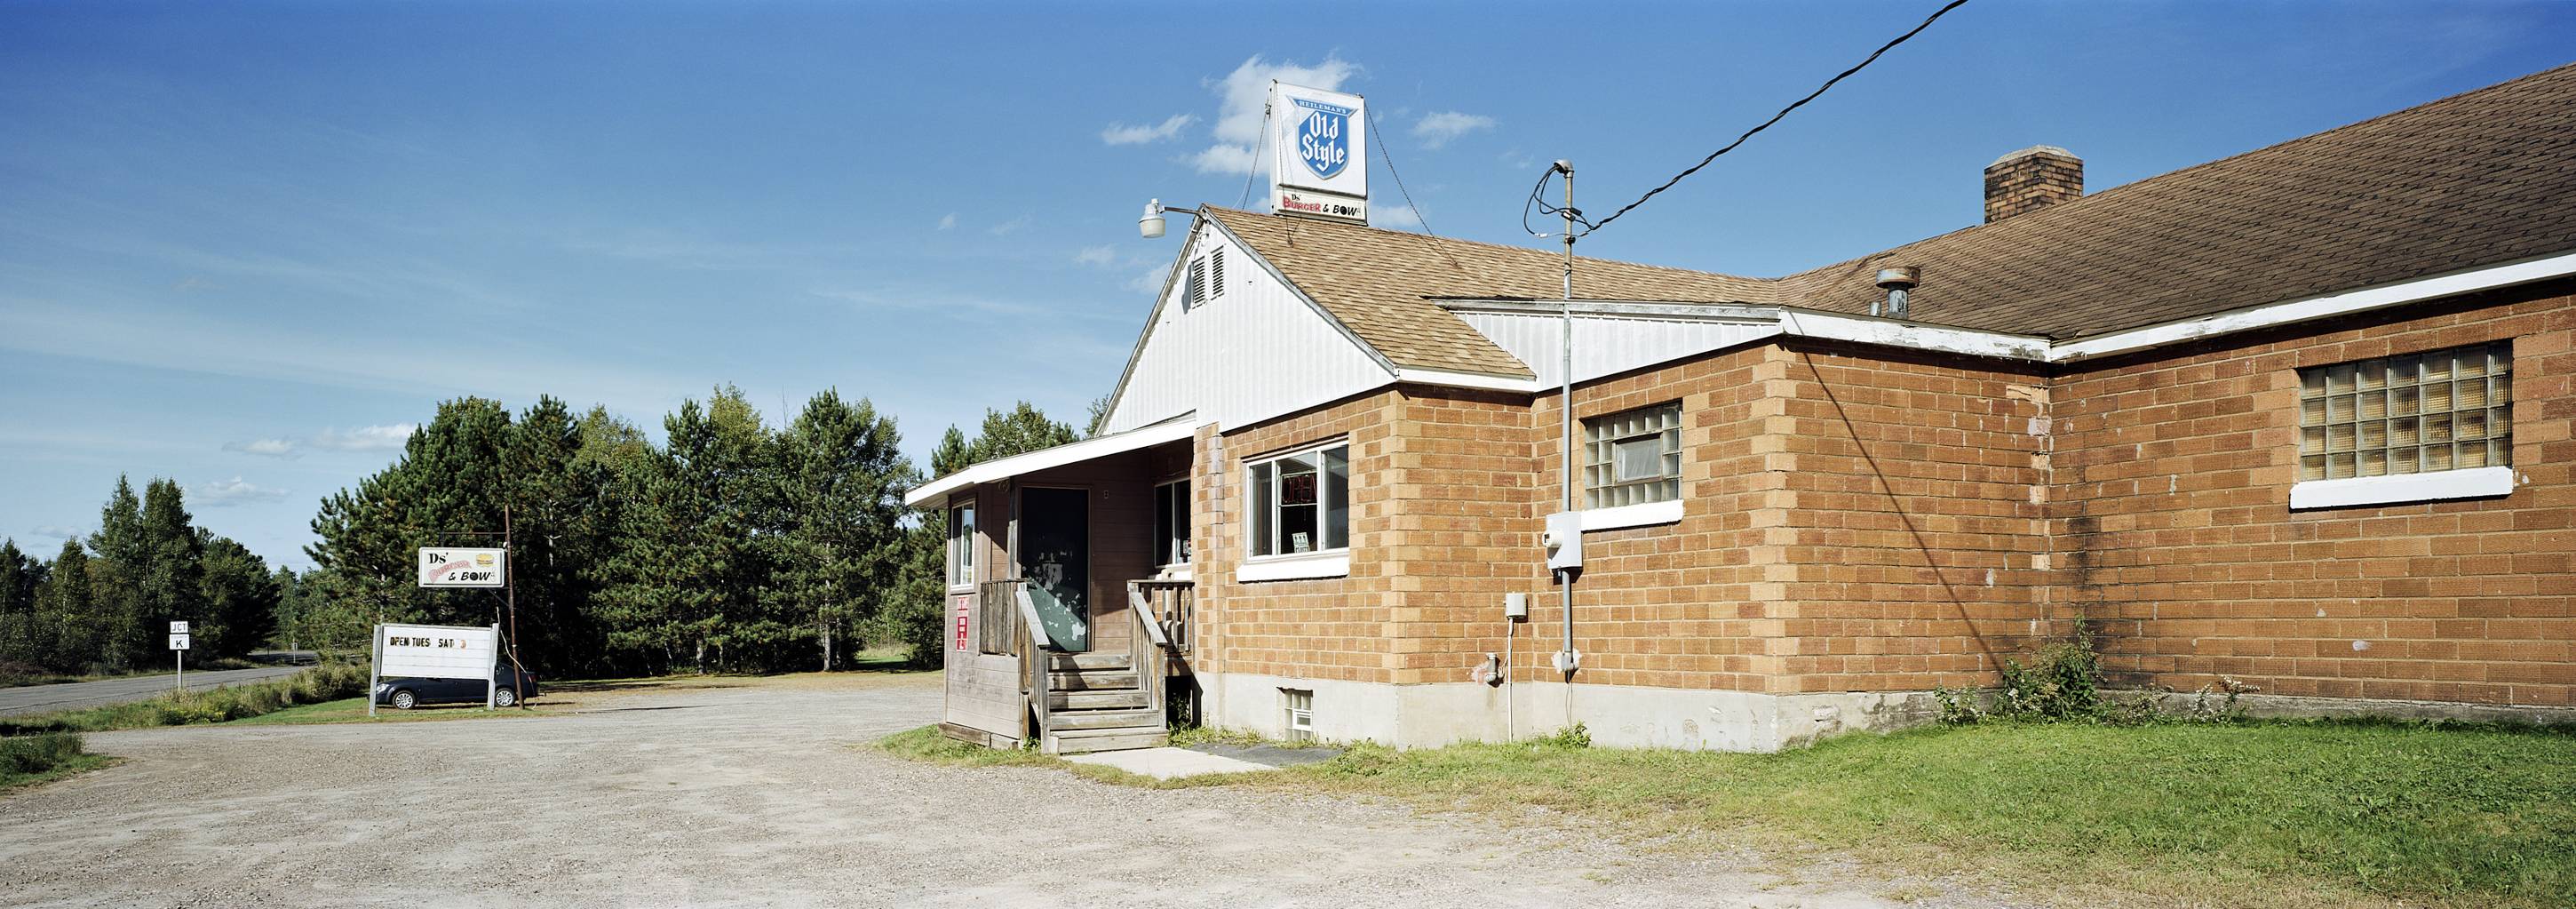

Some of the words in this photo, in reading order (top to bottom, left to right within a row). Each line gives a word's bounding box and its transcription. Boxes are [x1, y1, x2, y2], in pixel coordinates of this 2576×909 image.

[1298, 100, 1347, 114] HEILEMAN'S
[1309, 111, 1339, 140] Old
[1302, 132, 1345, 171] Style
[1323, 203, 1329, 212] &
[1282, 475, 1317, 506] OPEN
[449, 571, 456, 581] &
[390, 636, 409, 646] OPEN
[412, 637, 430, 647] TUES
[438, 638, 454, 648] SAT
